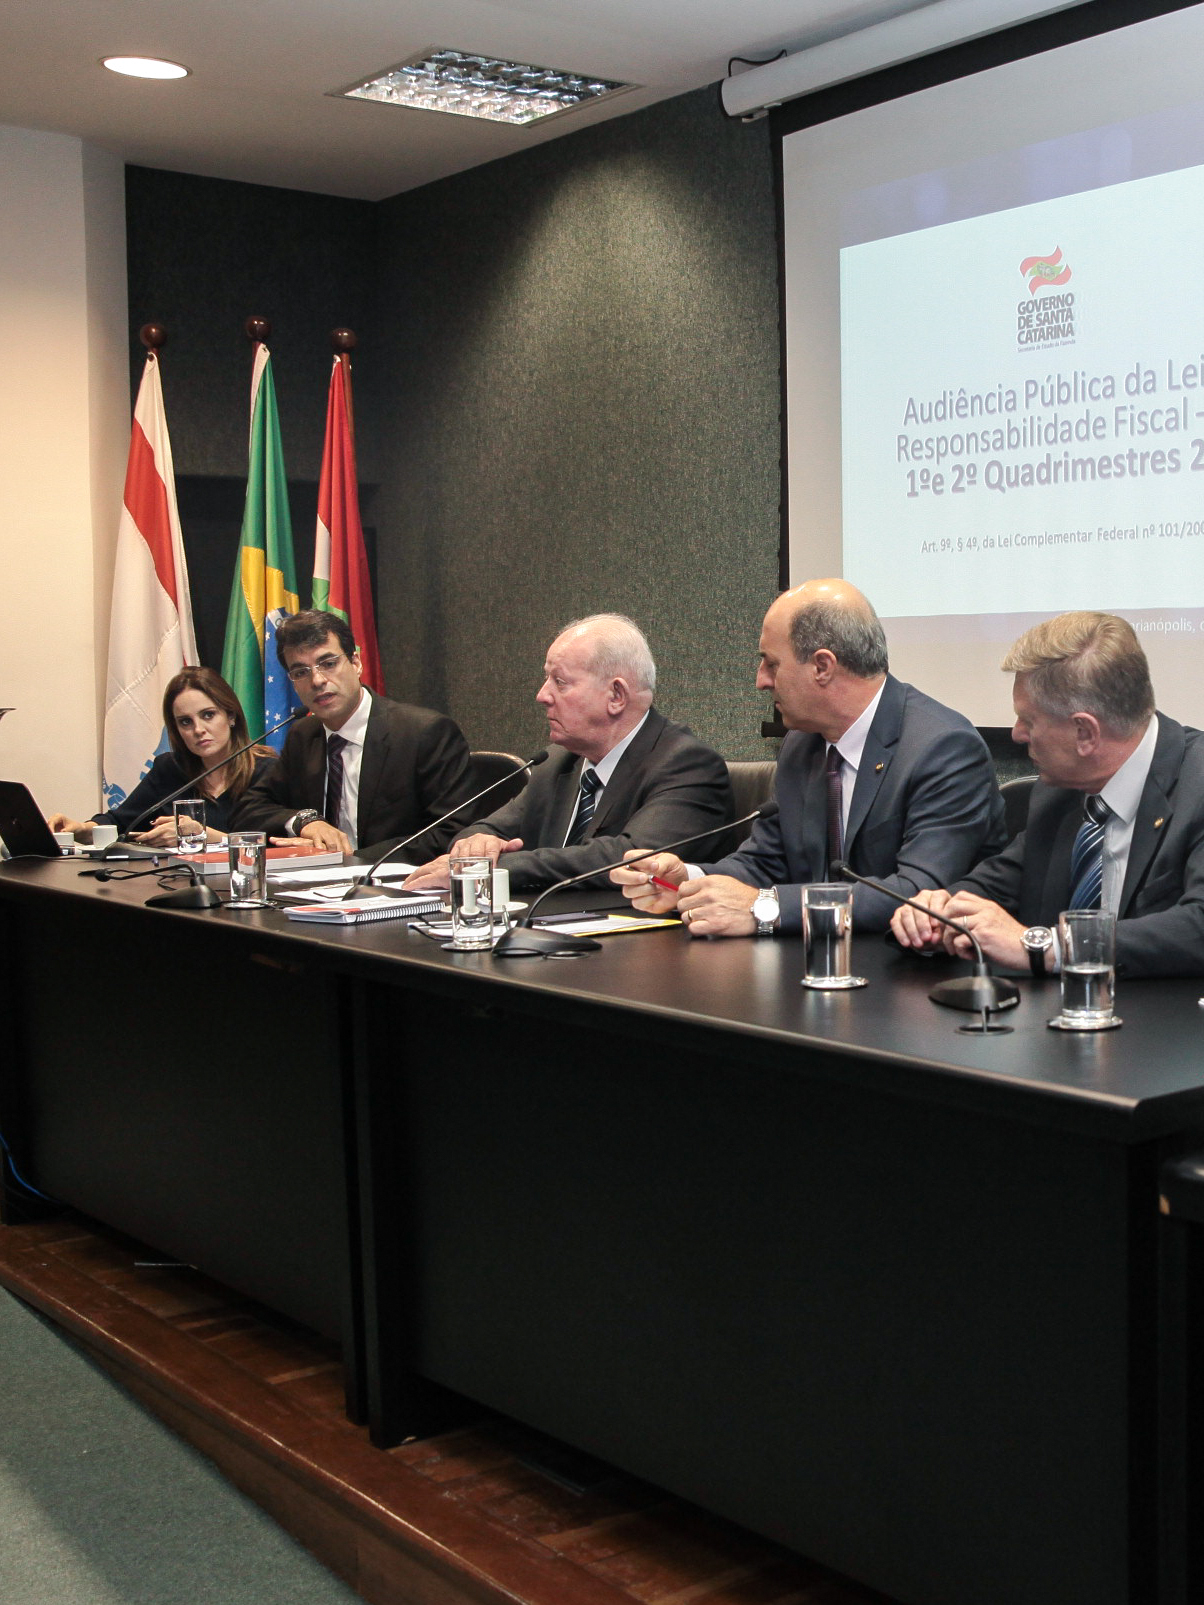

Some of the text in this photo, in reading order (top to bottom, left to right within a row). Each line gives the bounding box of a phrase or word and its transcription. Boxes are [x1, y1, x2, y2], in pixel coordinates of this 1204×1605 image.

[1017, 292, 1075, 315] GOVERNO
[1017, 307, 1074, 330] DE SANTA
[1017, 322, 1075, 345] CATARINA
[903, 383, 1017, 426] Audiência
[1024, 370, 1115, 410] Pública
[1124, 362, 1157, 396] da
[897, 408, 1107, 465] Responsabilidade
[1114, 396, 1188, 438] Fiscal
[951, 462, 977, 494] 2º
[984, 448, 1182, 494] Quadrimestres
[921, 540, 939, 553] Art.
[940, 538, 955, 553] 9º,
[957, 537, 963, 552] §
[966, 536, 980, 552] 4º,
[982, 535, 995, 549] da
[997, 534, 1012, 548] Lei
[1014, 531, 1093, 549] Complementar
[1097, 525, 1139, 542] Federal
[1142, 524, 1155, 539] nº
